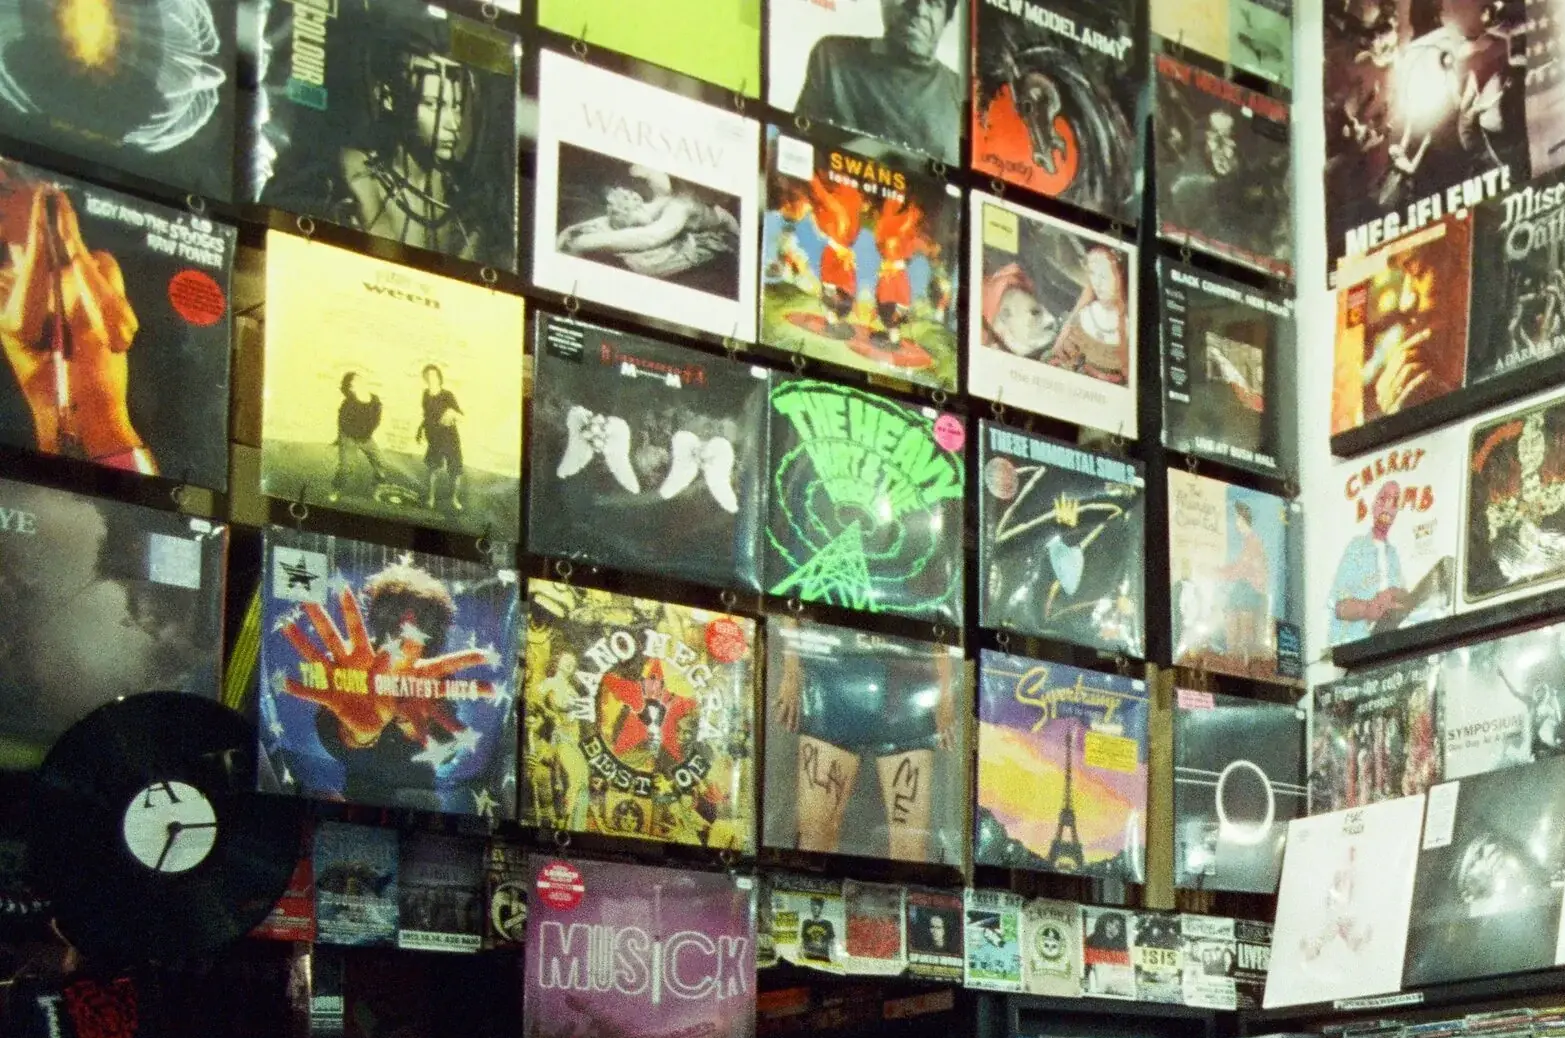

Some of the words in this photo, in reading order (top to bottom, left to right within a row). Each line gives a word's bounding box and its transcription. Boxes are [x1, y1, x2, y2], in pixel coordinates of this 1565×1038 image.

[1025, 4, 1081, 41] MODEL
[1081, 27, 1127, 61] ARMY
[581, 103, 725, 169] WARSAW
[829, 152, 907, 192] SWANS
[147, 233, 177, 256] RAW
[178, 242, 224, 269] POWER
[363, 280, 441, 310] ween
[772, 390, 850, 442] THE
[848, 397, 967, 502] HEAVY
[1343, 449, 1427, 502] CHERRY
[374, 673, 442, 700] GREATEST
[569, 630, 637, 724] MANO
[641, 628, 731, 744] NEGRA
[1447, 713, 1525, 741] SYMPOSIUM
[583, 736, 652, 797] BEST
[674, 742, 712, 788] OF
[540, 921, 748, 1006] MUSICK
[1141, 948, 1177, 967] ISIS
